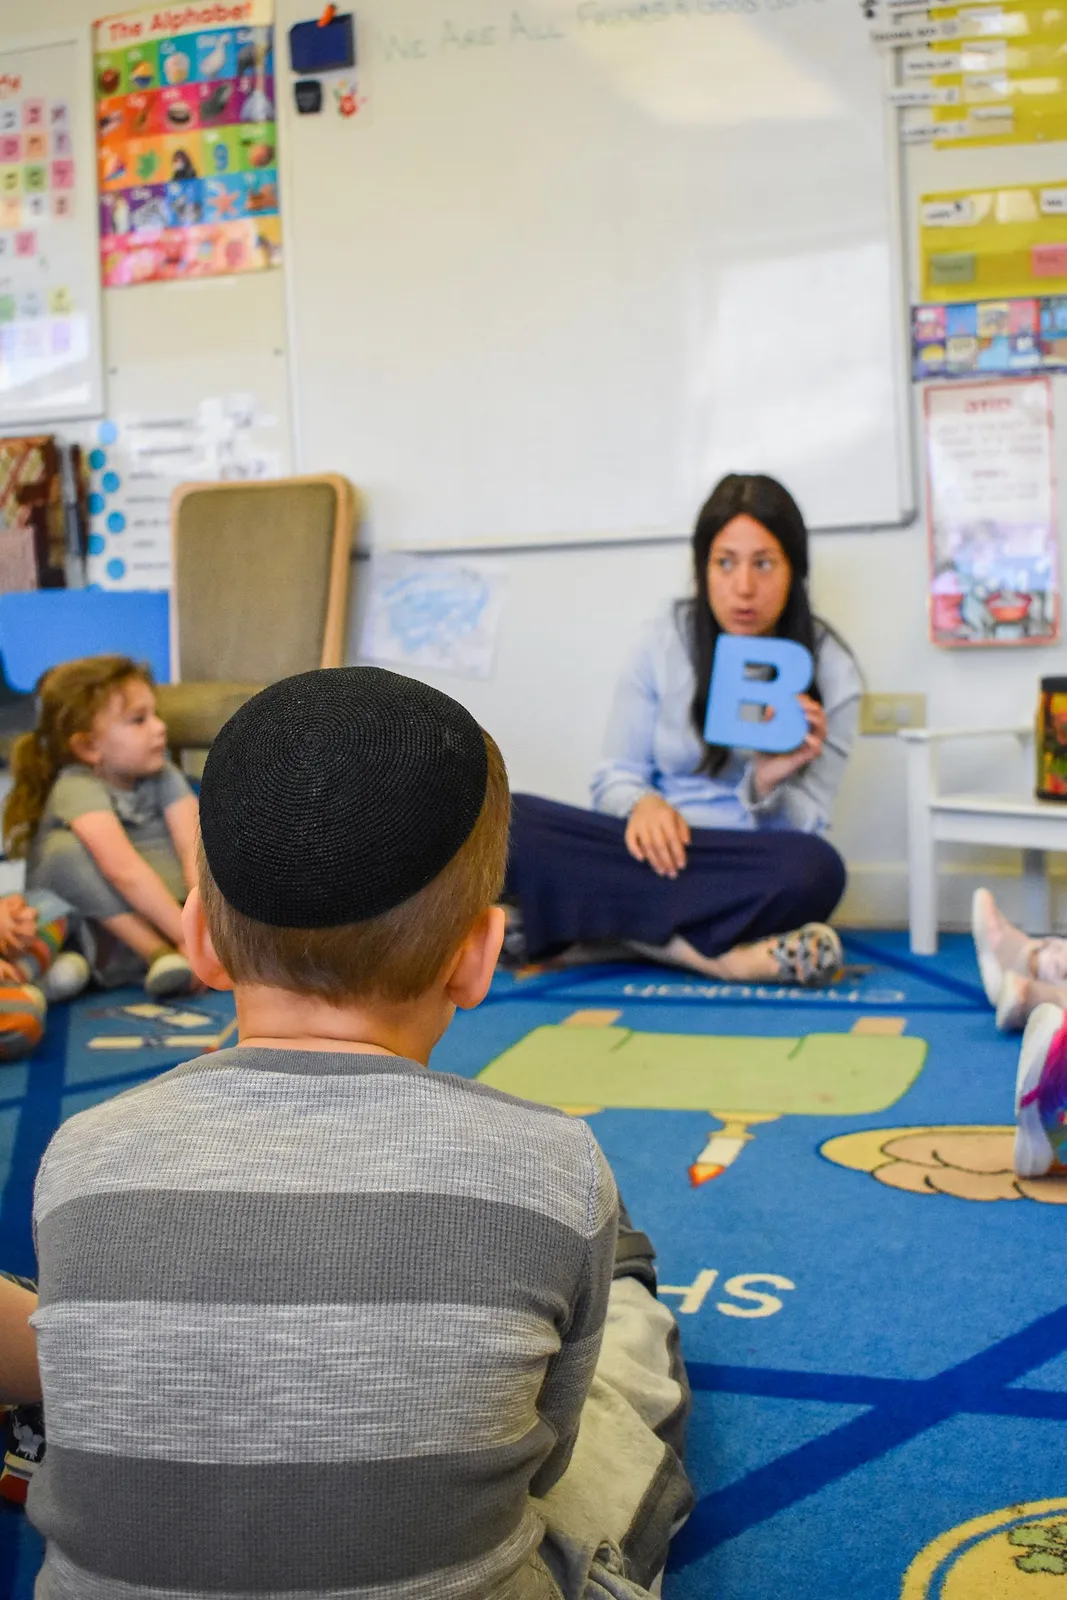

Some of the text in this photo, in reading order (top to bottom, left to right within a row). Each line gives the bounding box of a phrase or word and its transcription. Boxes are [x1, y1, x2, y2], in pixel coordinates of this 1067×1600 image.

[109, 2, 254, 42] The Alphabet
[704, 632, 814, 753] B
